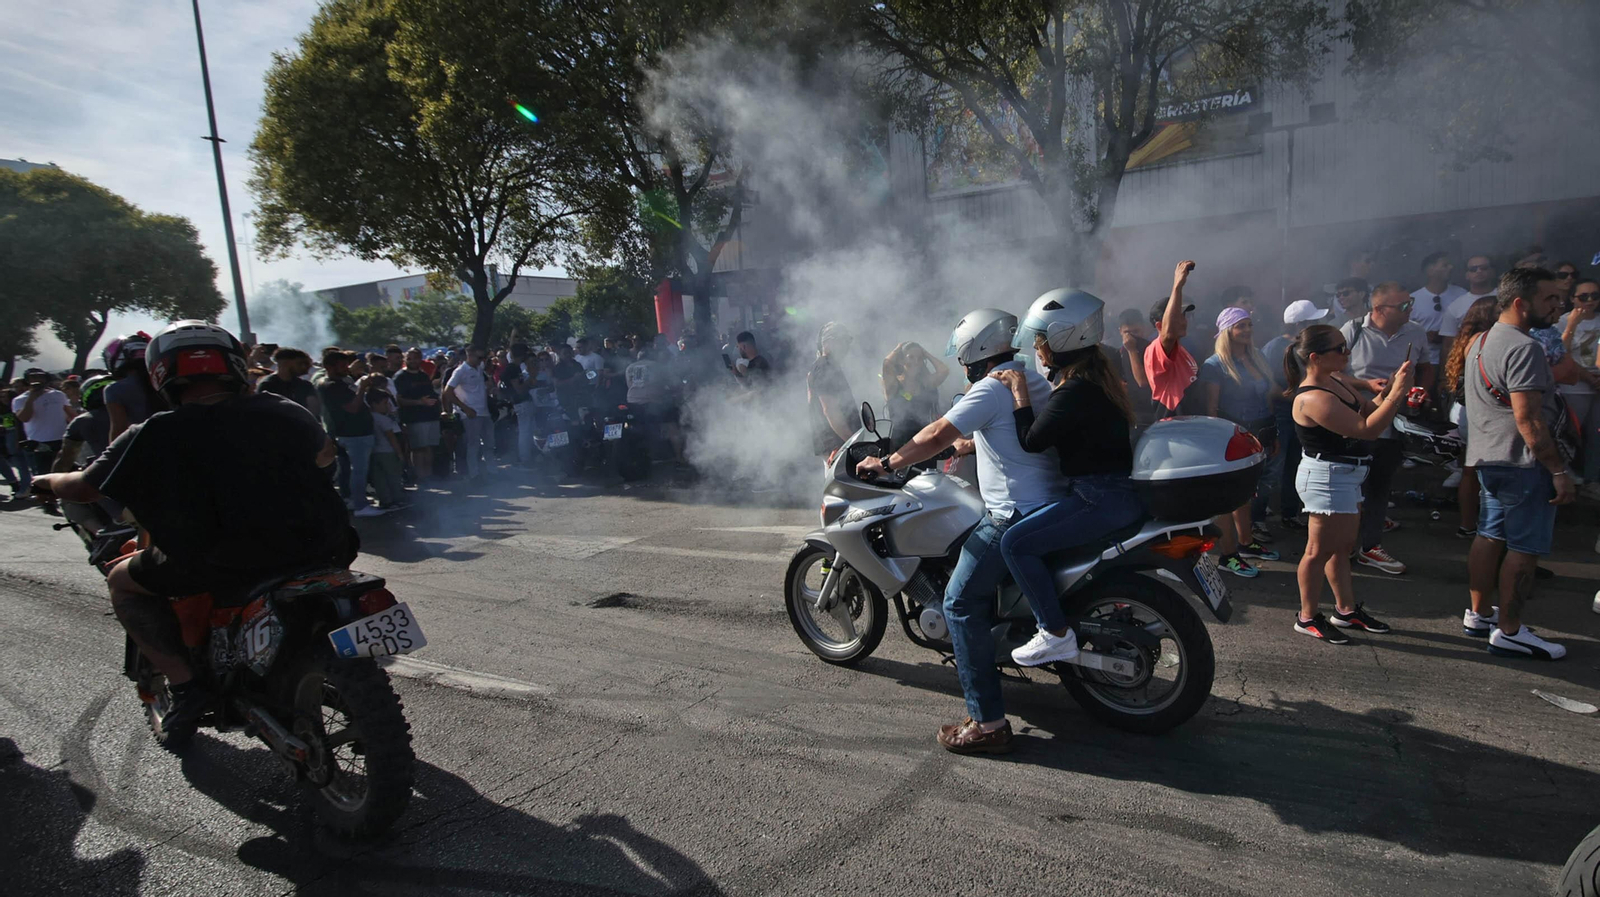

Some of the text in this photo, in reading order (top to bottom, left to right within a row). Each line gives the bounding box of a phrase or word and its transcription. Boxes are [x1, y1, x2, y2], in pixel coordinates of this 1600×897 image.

[245, 615, 270, 660] 16
[355, 609, 410, 645] 4533
[368, 630, 413, 658] CDS
